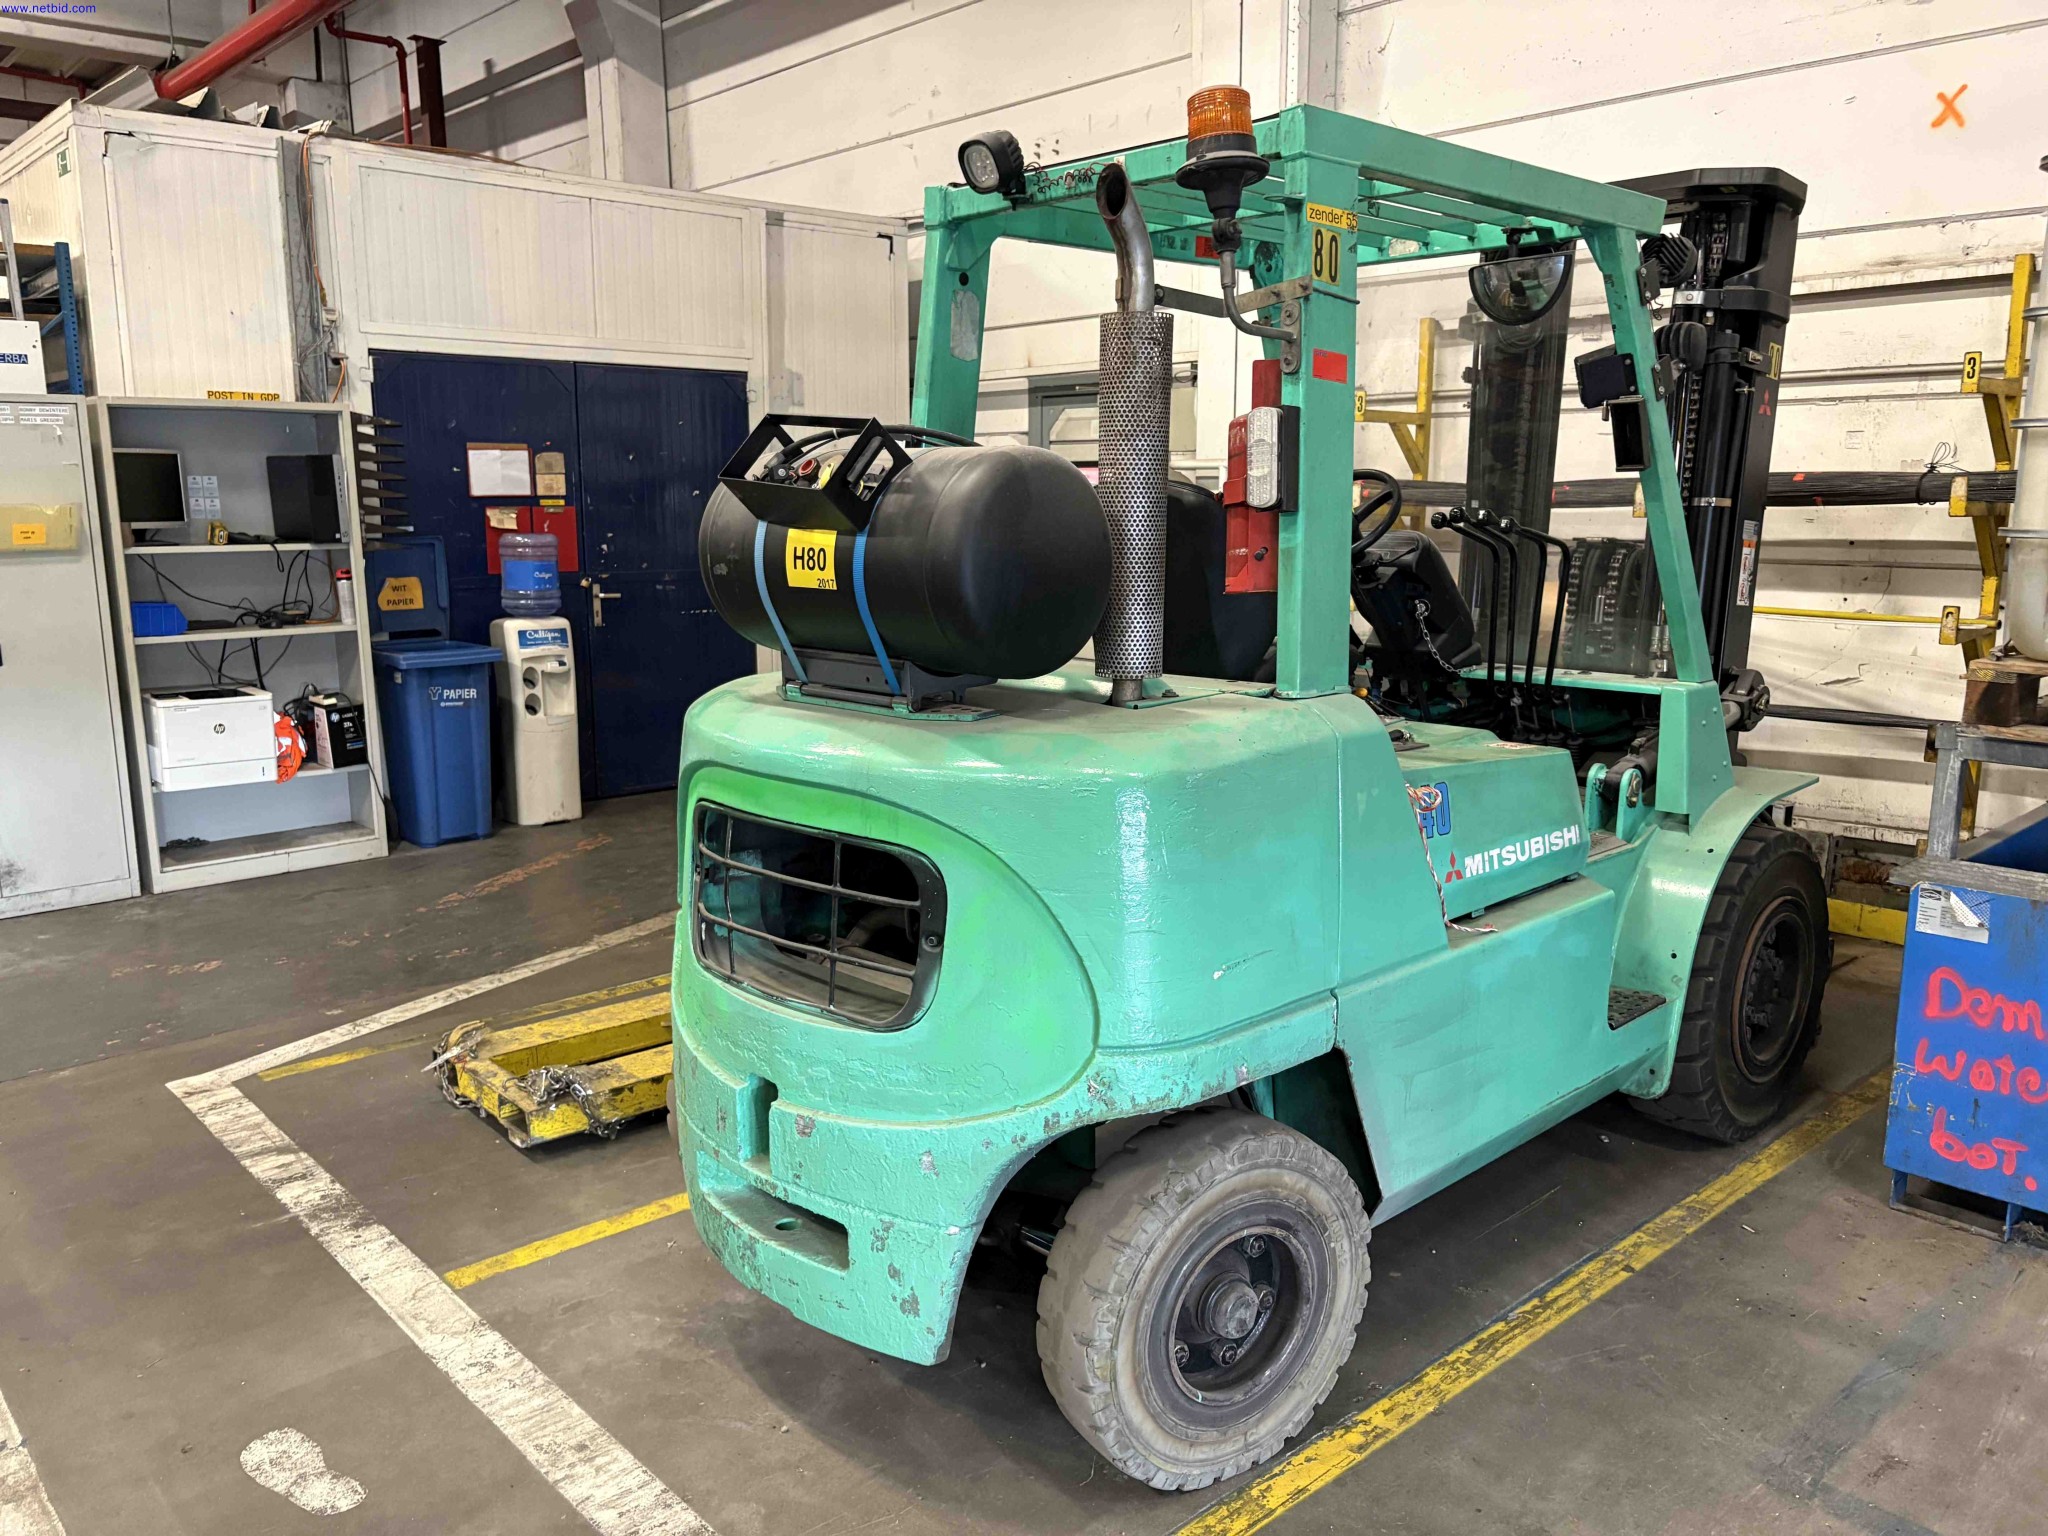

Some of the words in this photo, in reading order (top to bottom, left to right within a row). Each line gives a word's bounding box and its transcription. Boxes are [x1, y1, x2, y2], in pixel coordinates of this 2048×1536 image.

[1309, 207, 1343, 225] zender
[1314, 229, 1338, 283] 80
[1966, 356, 1977, 379] 3
[207, 391, 234, 399] POST
[242, 392, 254, 400] IN
[1357, 395, 1364, 412] 3
[793, 546, 827, 571] H80
[817, 578, 835, 588] 2017
[443, 688, 477, 700] PAPIER
[1464, 824, 1581, 878] MITSUBISHI
